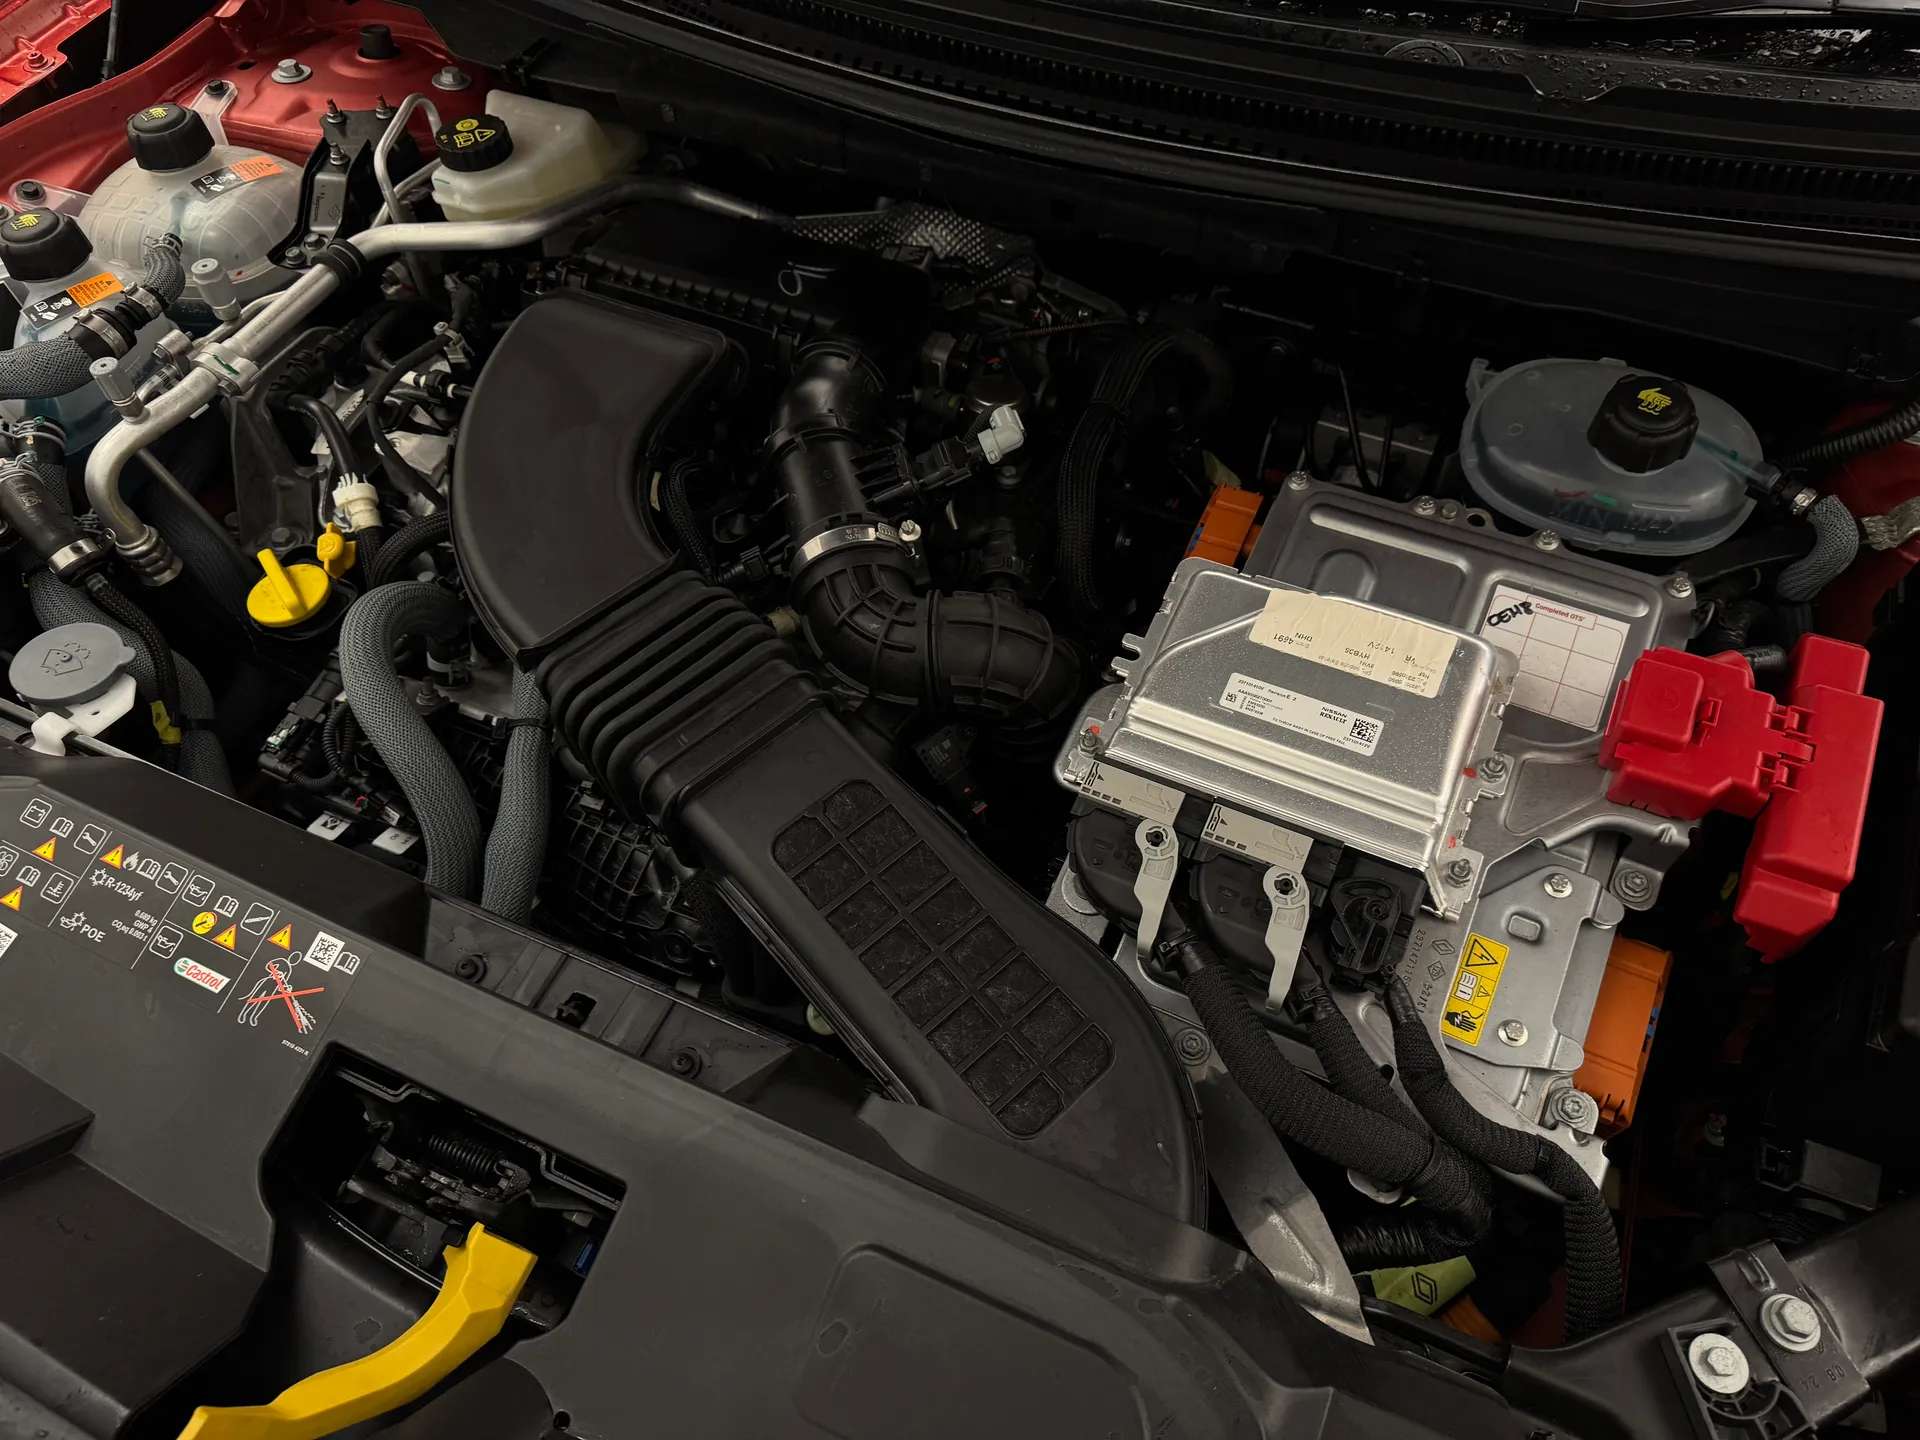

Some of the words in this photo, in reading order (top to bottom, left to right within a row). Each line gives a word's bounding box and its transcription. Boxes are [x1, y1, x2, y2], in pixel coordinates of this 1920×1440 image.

[1535, 602, 1570, 619] Completed
[1273, 633, 1294, 645] 4691
[1319, 711, 1347, 724] RENAULT
[1321, 706, 1348, 719] NISSAN
[105, 876, 144, 902] R-1234yf
[134, 919, 149, 931] GWP
[80, 924, 106, 943] POE
[185, 962, 225, 990] Castrol
